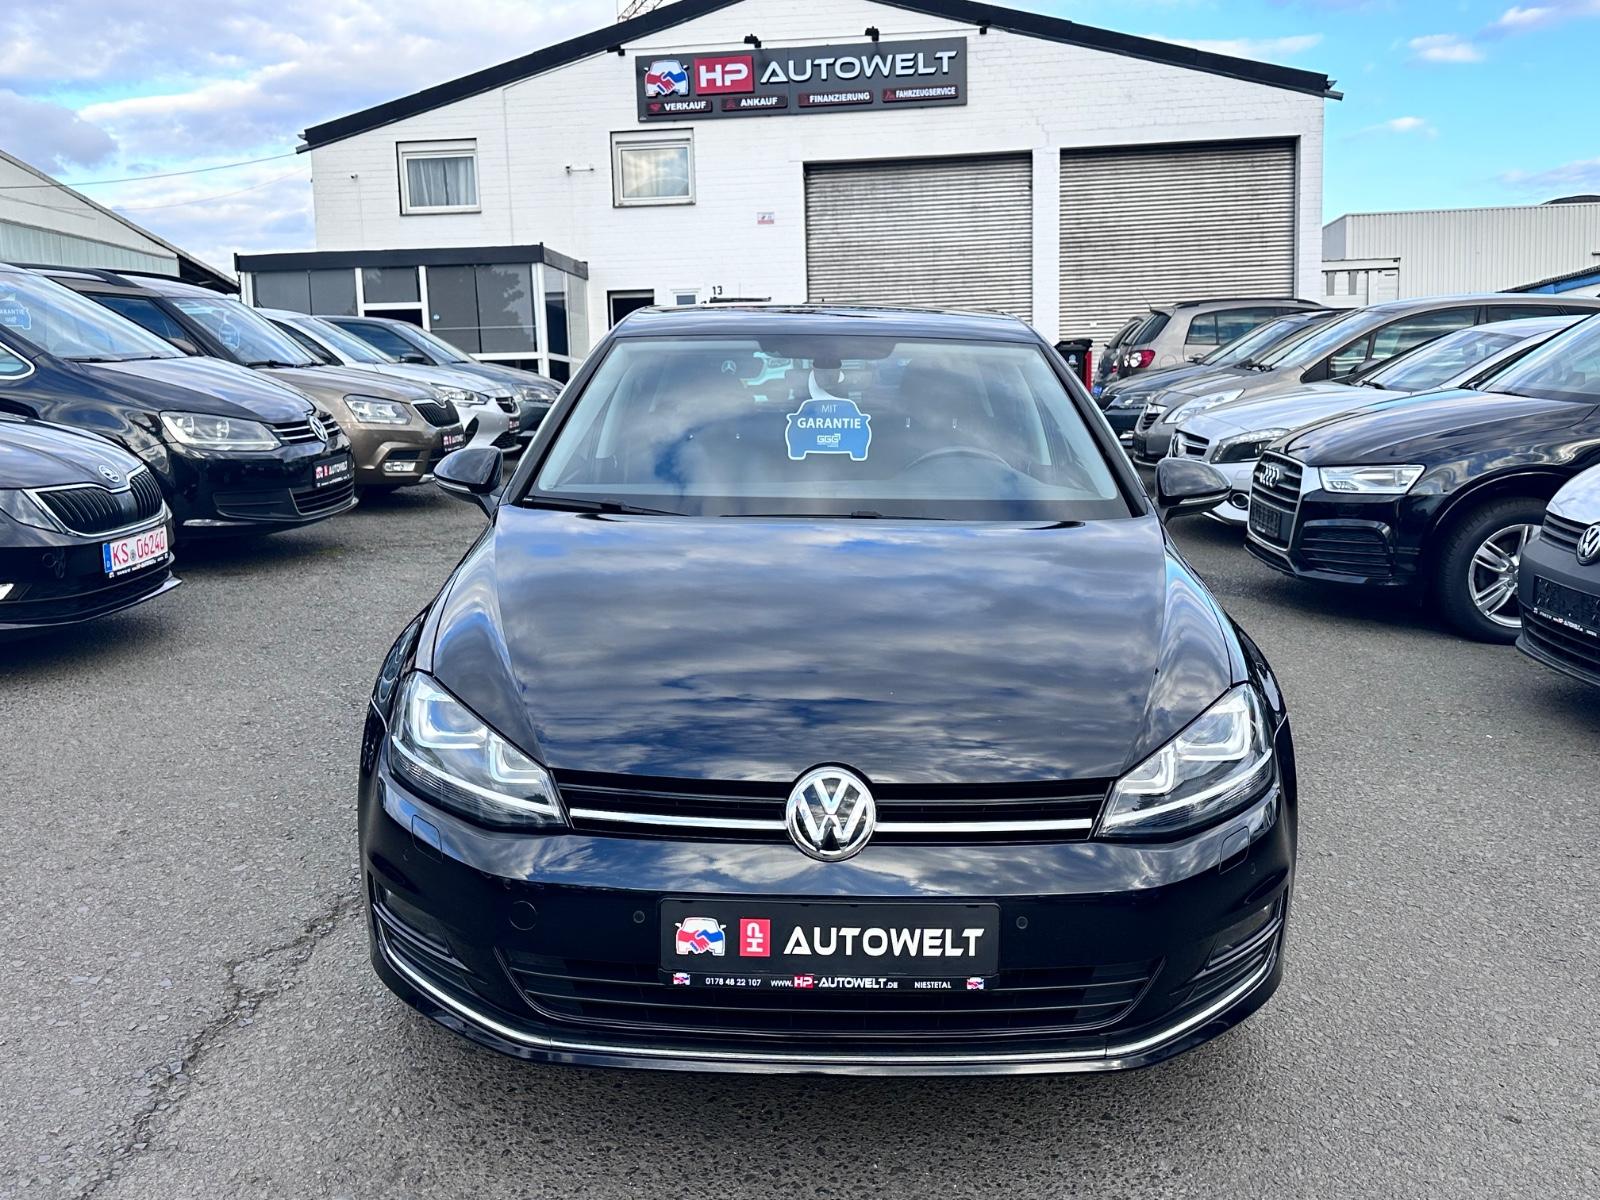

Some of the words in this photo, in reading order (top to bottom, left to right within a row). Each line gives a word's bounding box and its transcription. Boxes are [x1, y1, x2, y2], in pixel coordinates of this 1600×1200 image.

[699, 63, 749, 87] HP
[760, 50, 958, 83] AUTOWELT
[896, 86, 956, 98] FAHRZEUGSERVICE
[740, 97, 778, 107] ANKAUF
[809, 92, 870, 103] FINANZIERUNG
[664, 101, 707, 111] VERKAUF
[712, 285, 723, 295] 13
[821, 404, 838, 413] MIT
[797, 417, 862, 429] GARANTIE
[112, 542, 129, 567] KS
[136, 530, 165, 559] 06240
[783, 926, 985, 957] AUTOWELT
[705, 977, 724, 986] 0178
[725, 977, 735, 986] 48
[736, 978, 746, 986] 22
[748, 978, 762, 987] 107
[914, 981, 952, 989] NIESTETAL
